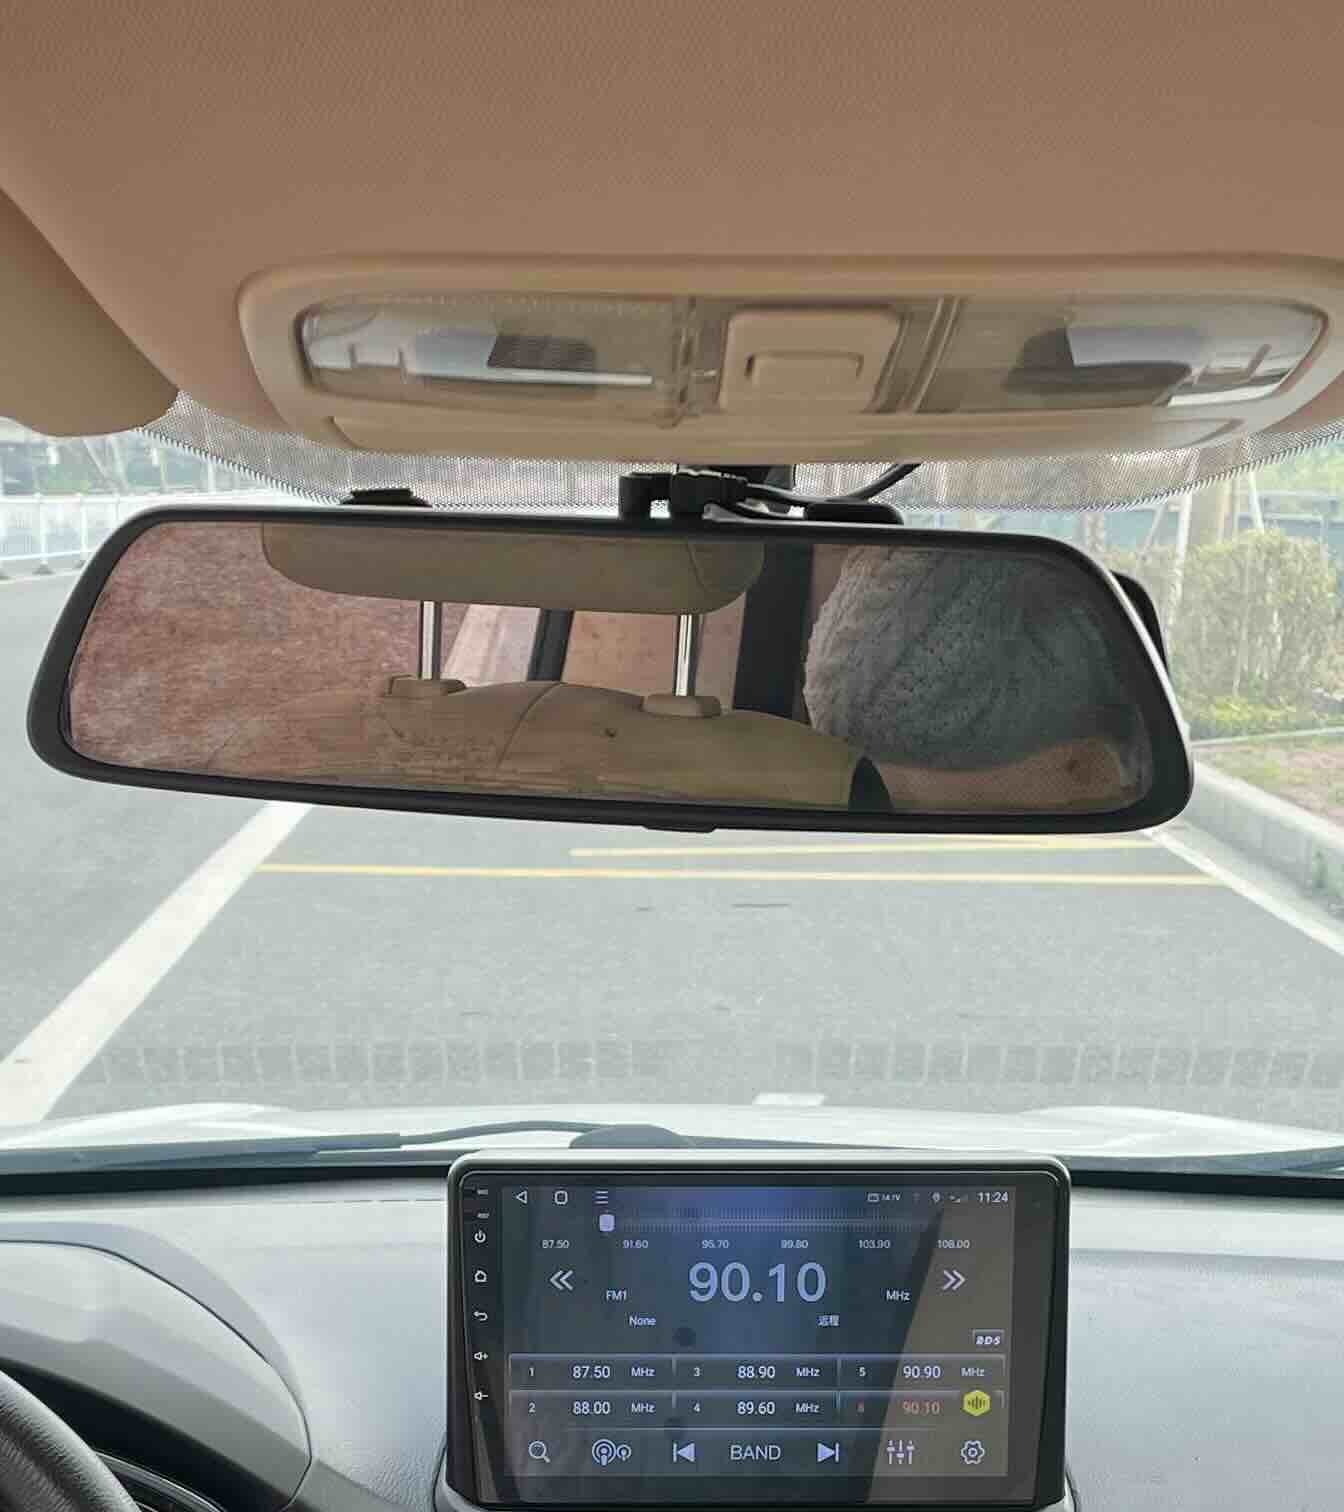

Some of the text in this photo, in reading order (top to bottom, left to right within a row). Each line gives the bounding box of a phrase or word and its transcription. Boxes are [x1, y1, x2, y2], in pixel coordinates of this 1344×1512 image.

[977, 1191, 1008, 1203] 11:24
[541, 1239, 570, 1249] 87.50
[858, 1239, 891, 1249] 103.90
[688, 1261, 827, 1303] 90.10
[606, 1289, 627, 1301] FM1
[886, 1289, 910, 1301] MHz
[629, 1315, 656, 1327] None
[572, 1366, 611, 1378] 87.50
[631, 1368, 655, 1378] MHz
[737, 1366, 776, 1378] 88.90
[796, 1368, 820, 1378] MHz
[903, 1366, 942, 1378] 90.90
[961, 1368, 985, 1378] MHz
[572, 1401, 611, 1414] 88.00
[631, 1403, 655, 1413] MHz
[737, 1401, 776, 1414] 89.60
[795, 1403, 820, 1413] MHz
[730, 1445, 782, 1462] BAND
